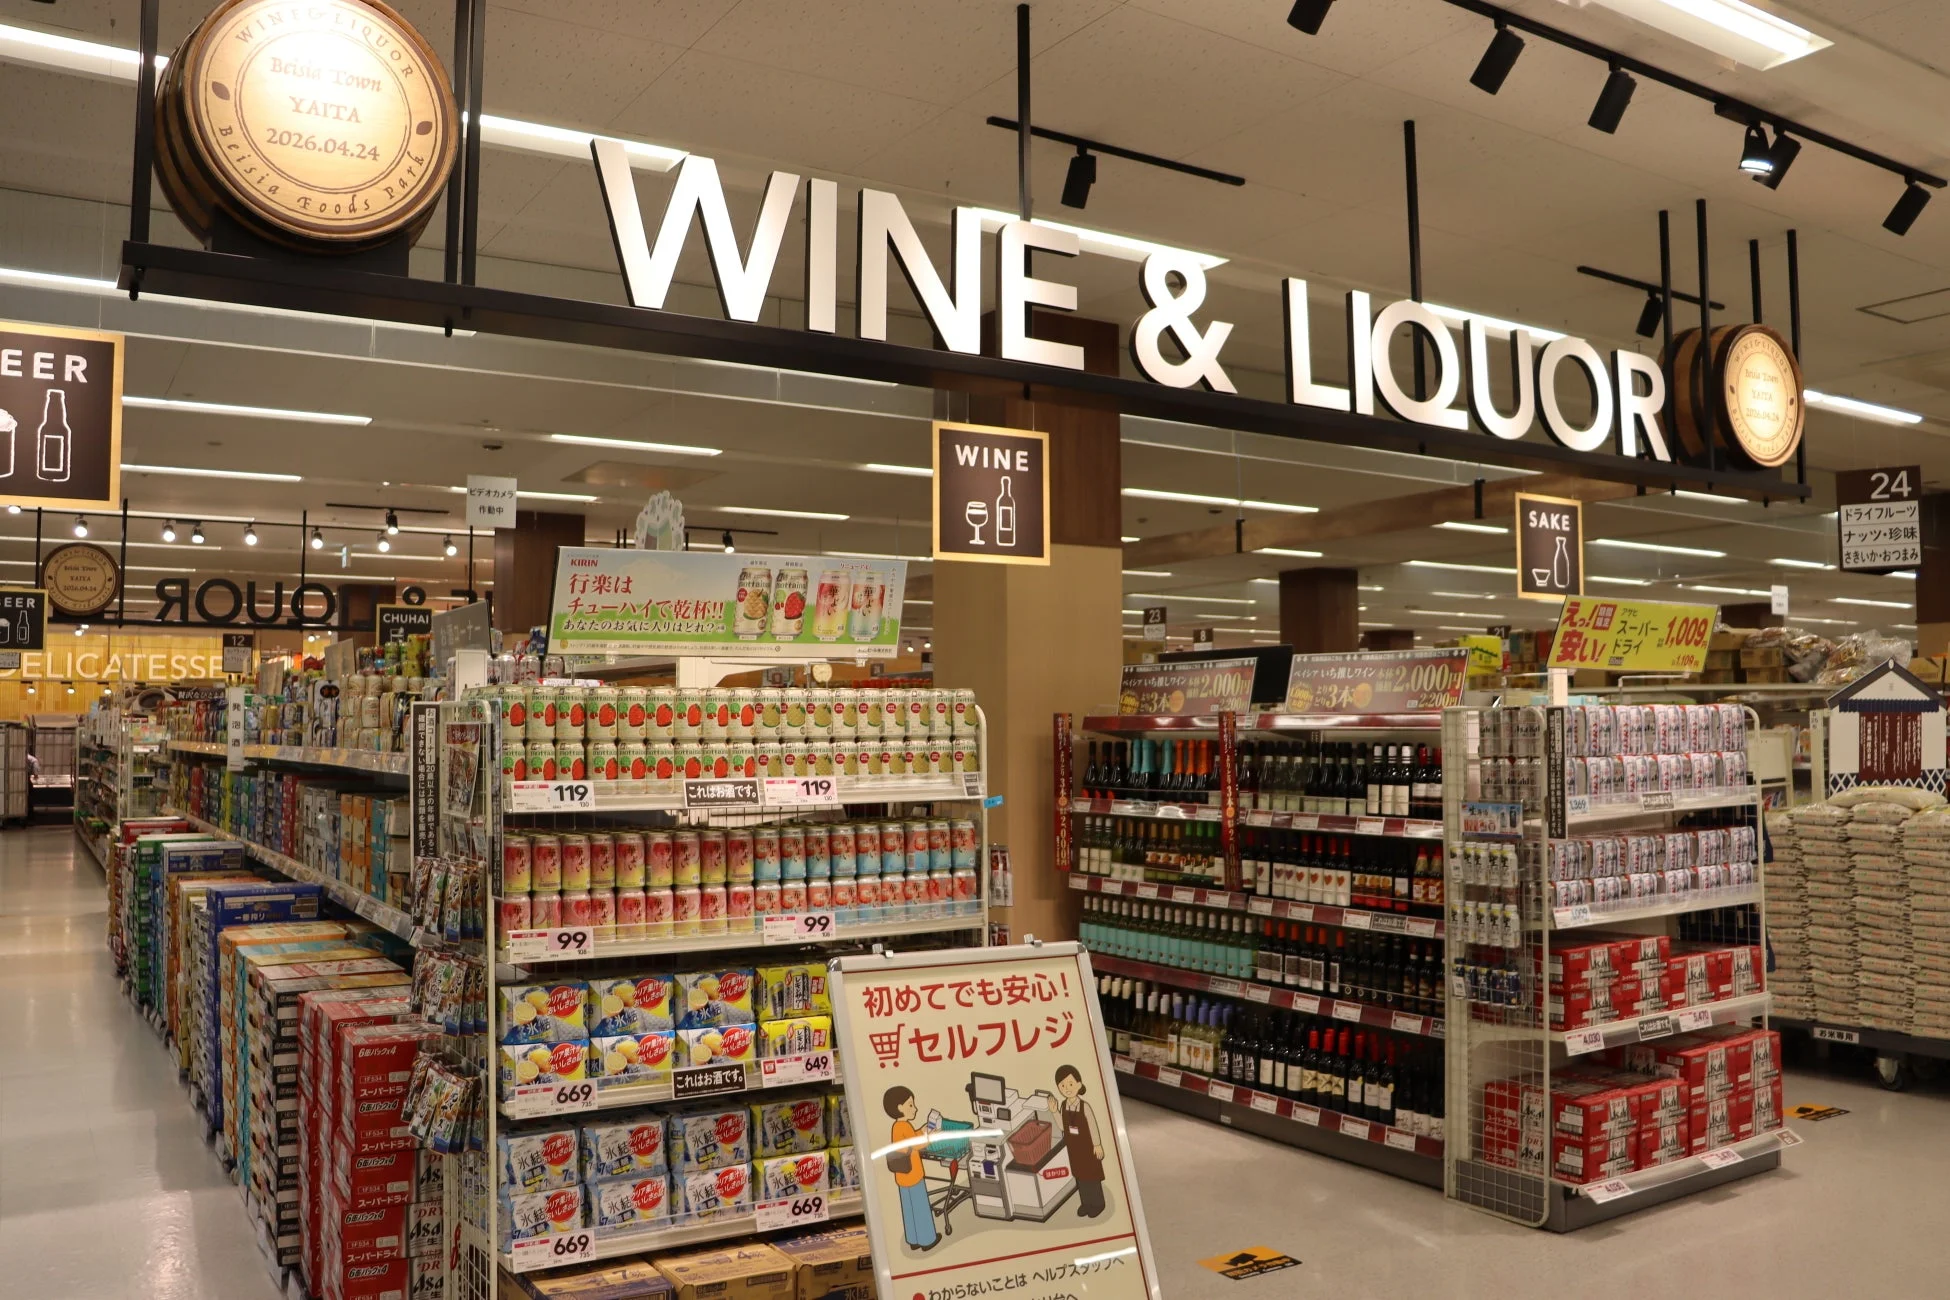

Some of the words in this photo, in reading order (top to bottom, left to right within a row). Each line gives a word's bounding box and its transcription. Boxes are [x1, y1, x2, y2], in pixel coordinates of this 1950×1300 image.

[270, 57, 321, 82] Beisia
[331, 67, 384, 94] Town
[289, 95, 361, 124] YAITA
[265, 127, 381, 162] 2026.04.24
[219, 125, 280, 196] Beisia
[297, 194, 371, 215] Foods
[383, 150, 425, 200] Park
[590, 138, 1084, 371] WINE
[1129, 250, 1238, 394] &
[1281, 276, 1672, 462] LIQUOR
[955, 444, 1029, 472] WINE
[1870, 470, 1912, 499] 24
[469, 488, 514, 499] ビデオカメラ
[479, 505, 504, 515] 作動中
[1845, 506, 1917, 521] ドライフルーツ
[1529, 510, 1570, 532] SAKE
[1844, 527, 1917, 543] ナッツ・珍味
[570, 559, 598, 567] KIRIN
[1844, 548, 1919, 564] さきいか・おつまみ
[569, 573, 633, 595] 行楽は
[0, 597, 35, 608] EER
[383, 613, 429, 625] CHUHAI
[1149, 609, 1161, 623] 23
[563, 619, 715, 633] あなたのお気に入りはどれ?
[1617, 620, 1659, 636] スーパー
[232, 635, 245, 646] 12
[1556, 630, 1607, 662] 安い!
[1612, 638, 1644, 655] ドライ
[0, 650, 224, 679] ELICATESSE
[232, 702, 241, 748] 発泡酒
[554, 784, 588, 802] 119
[689, 783, 757, 799] これはお酒です。
[801, 780, 831, 796] 119
[804, 915, 831, 932] 99
[557, 931, 588, 950] 99
[863, 972, 1069, 1018] 初めてでも安心!
[908, 1012, 1074, 1063] セルフレジ
[1583, 1033, 1601, 1045] 4,030
[805, 1055, 829, 1072] 649
[676, 1067, 743, 1090] これはお酒です。
[360, 1086, 407, 1097] スーパードラ
[556, 1084, 592, 1103] 669
[771, 1117, 793, 1133] 氷結
[361, 1139, 412, 1152] スーパードライ
[692, 1130, 714, 1148] 氷結
[606, 1142, 629, 1159] 氷結
[518, 1151, 543, 1170] 氷結
[773, 1173, 795, 1188] 氷結
[358, 1194, 409, 1208] スーパードライ
[692, 1184, 715, 1202] 氷結
[608, 1197, 632, 1214] 氷結
[792, 1196, 822, 1216] 669
[520, 1208, 545, 1227] 氷結
[410, 1219, 443, 1241] Asa
[553, 1234, 590, 1256] 669
[347, 1249, 399, 1263] スーパードライ
[421, 1261, 440, 1272] DR
[413, 1273, 443, 1294] Asa
[928, 1274, 1028, 1300] わからないことは
